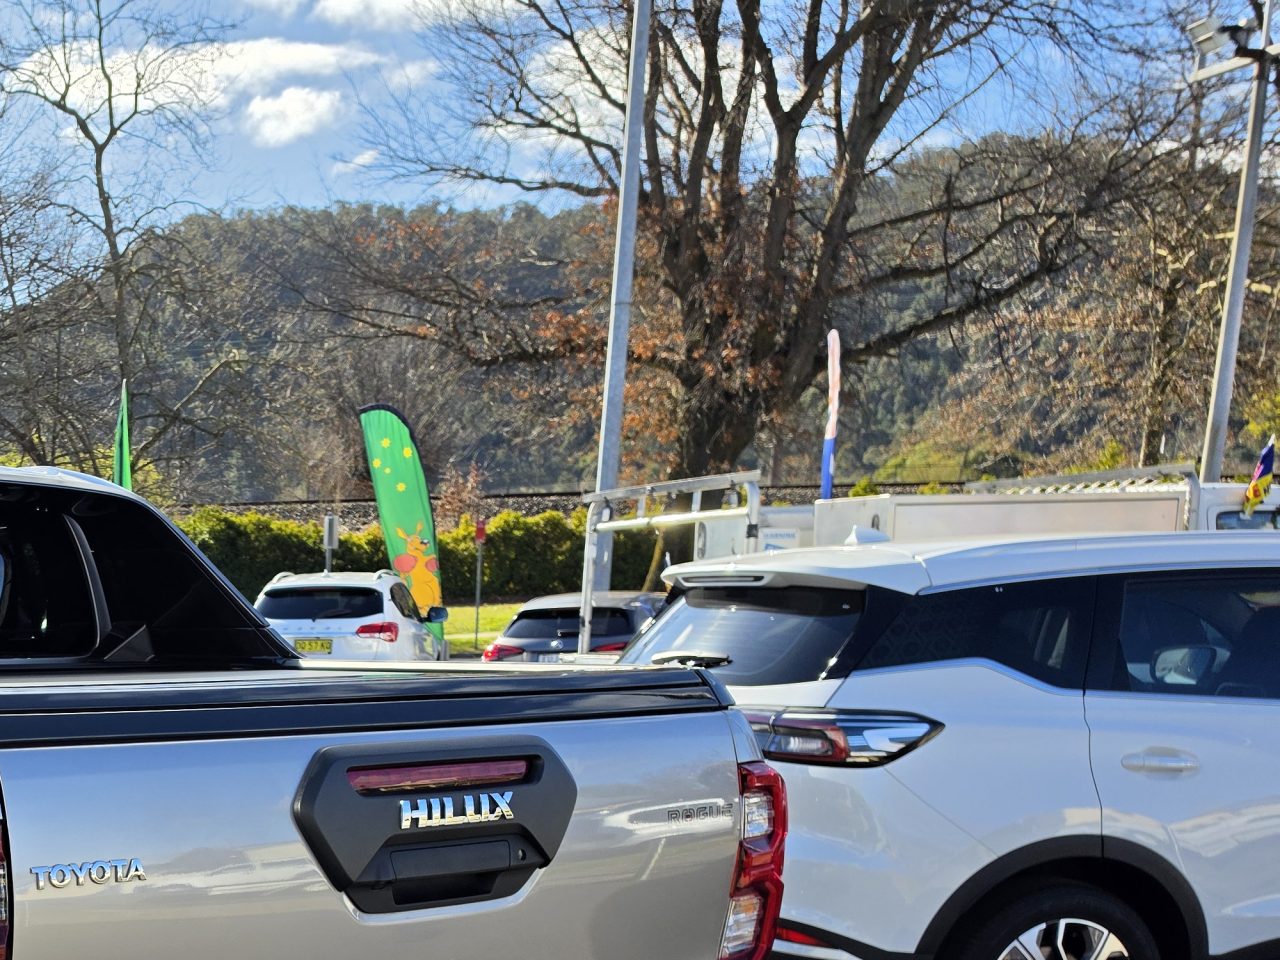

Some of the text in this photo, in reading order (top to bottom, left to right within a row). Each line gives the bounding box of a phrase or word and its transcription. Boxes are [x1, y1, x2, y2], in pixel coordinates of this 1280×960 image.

[400, 791, 514, 829] HILUX
[667, 803, 734, 824] ROGUE
[30, 858, 146, 890] TOYOTA
